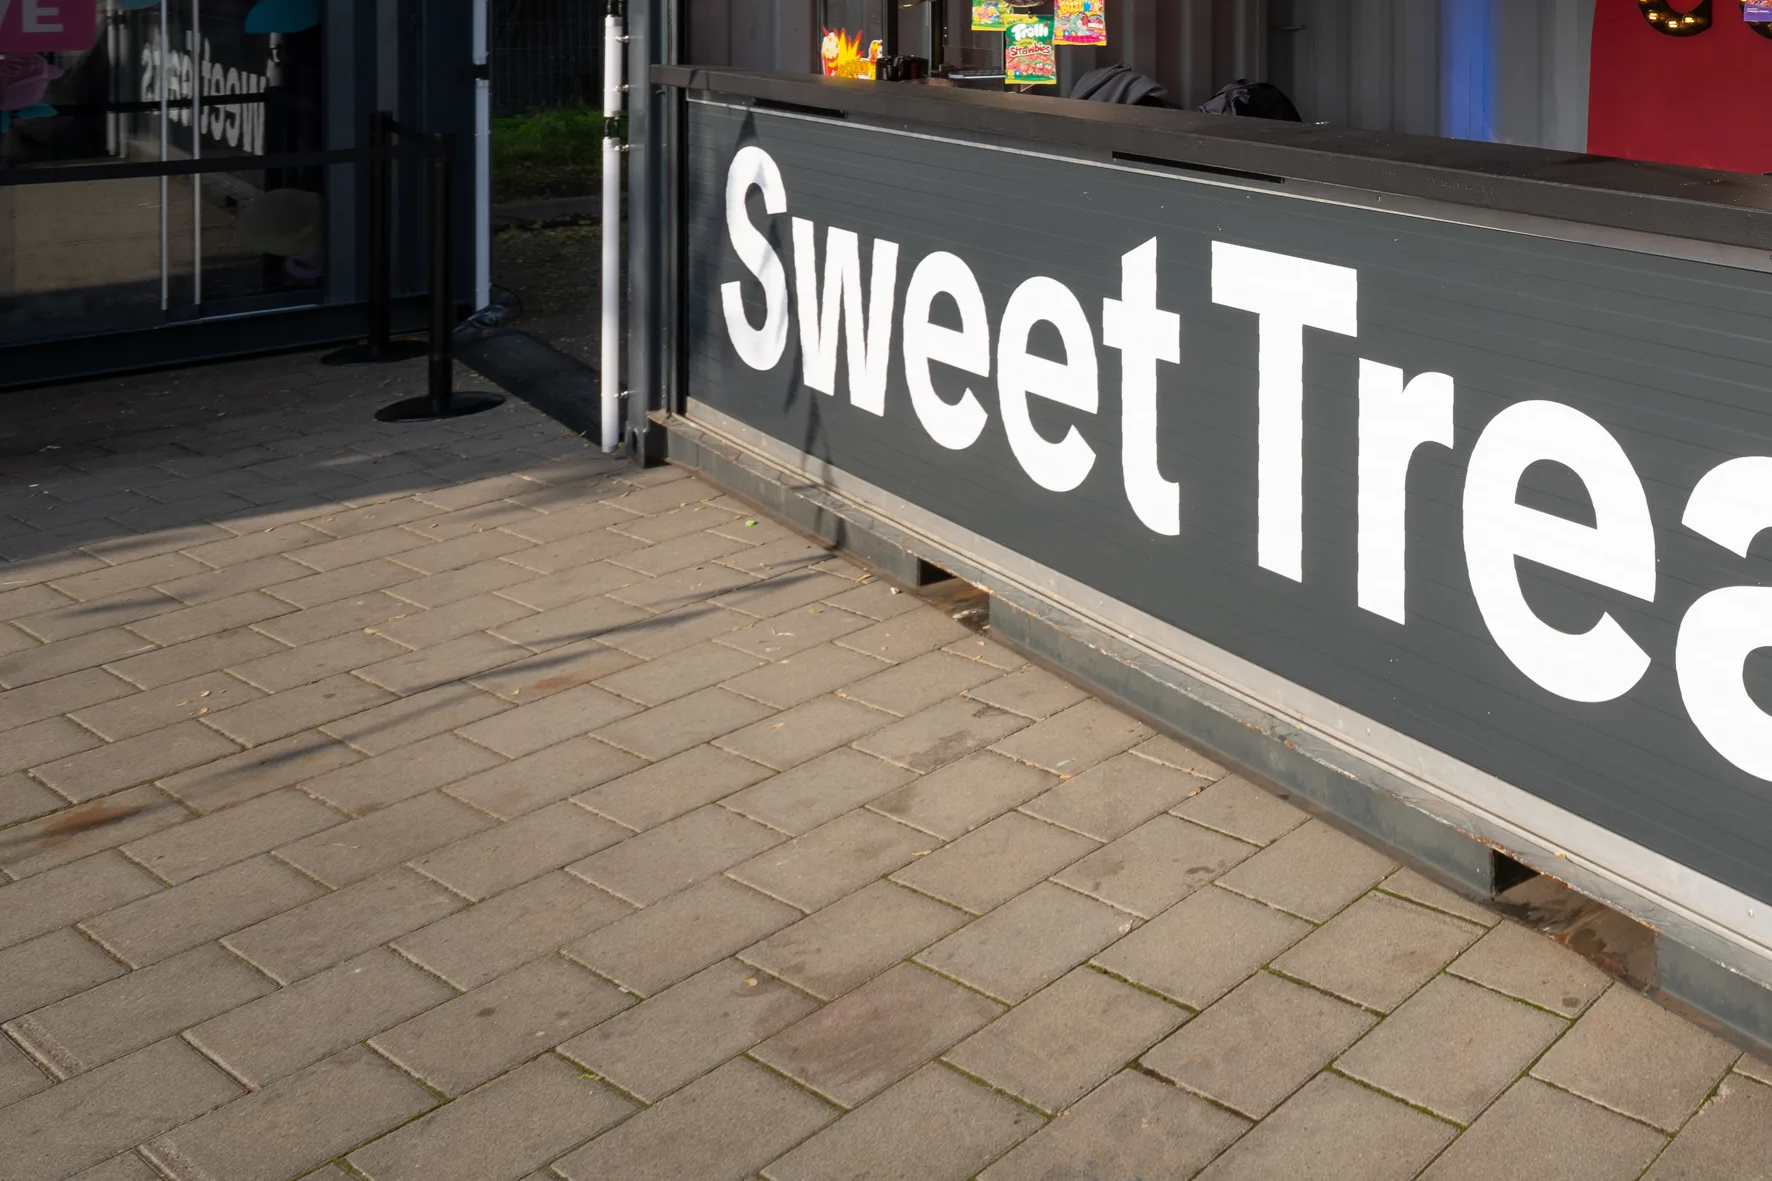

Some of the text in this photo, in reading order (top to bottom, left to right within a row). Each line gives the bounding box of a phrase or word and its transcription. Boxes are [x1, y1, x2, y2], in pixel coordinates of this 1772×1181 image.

[1011, 21, 1048, 41] Trolli
[1009, 42, 1051, 56] Strawbies
[721, 146, 1180, 536] Sweet
